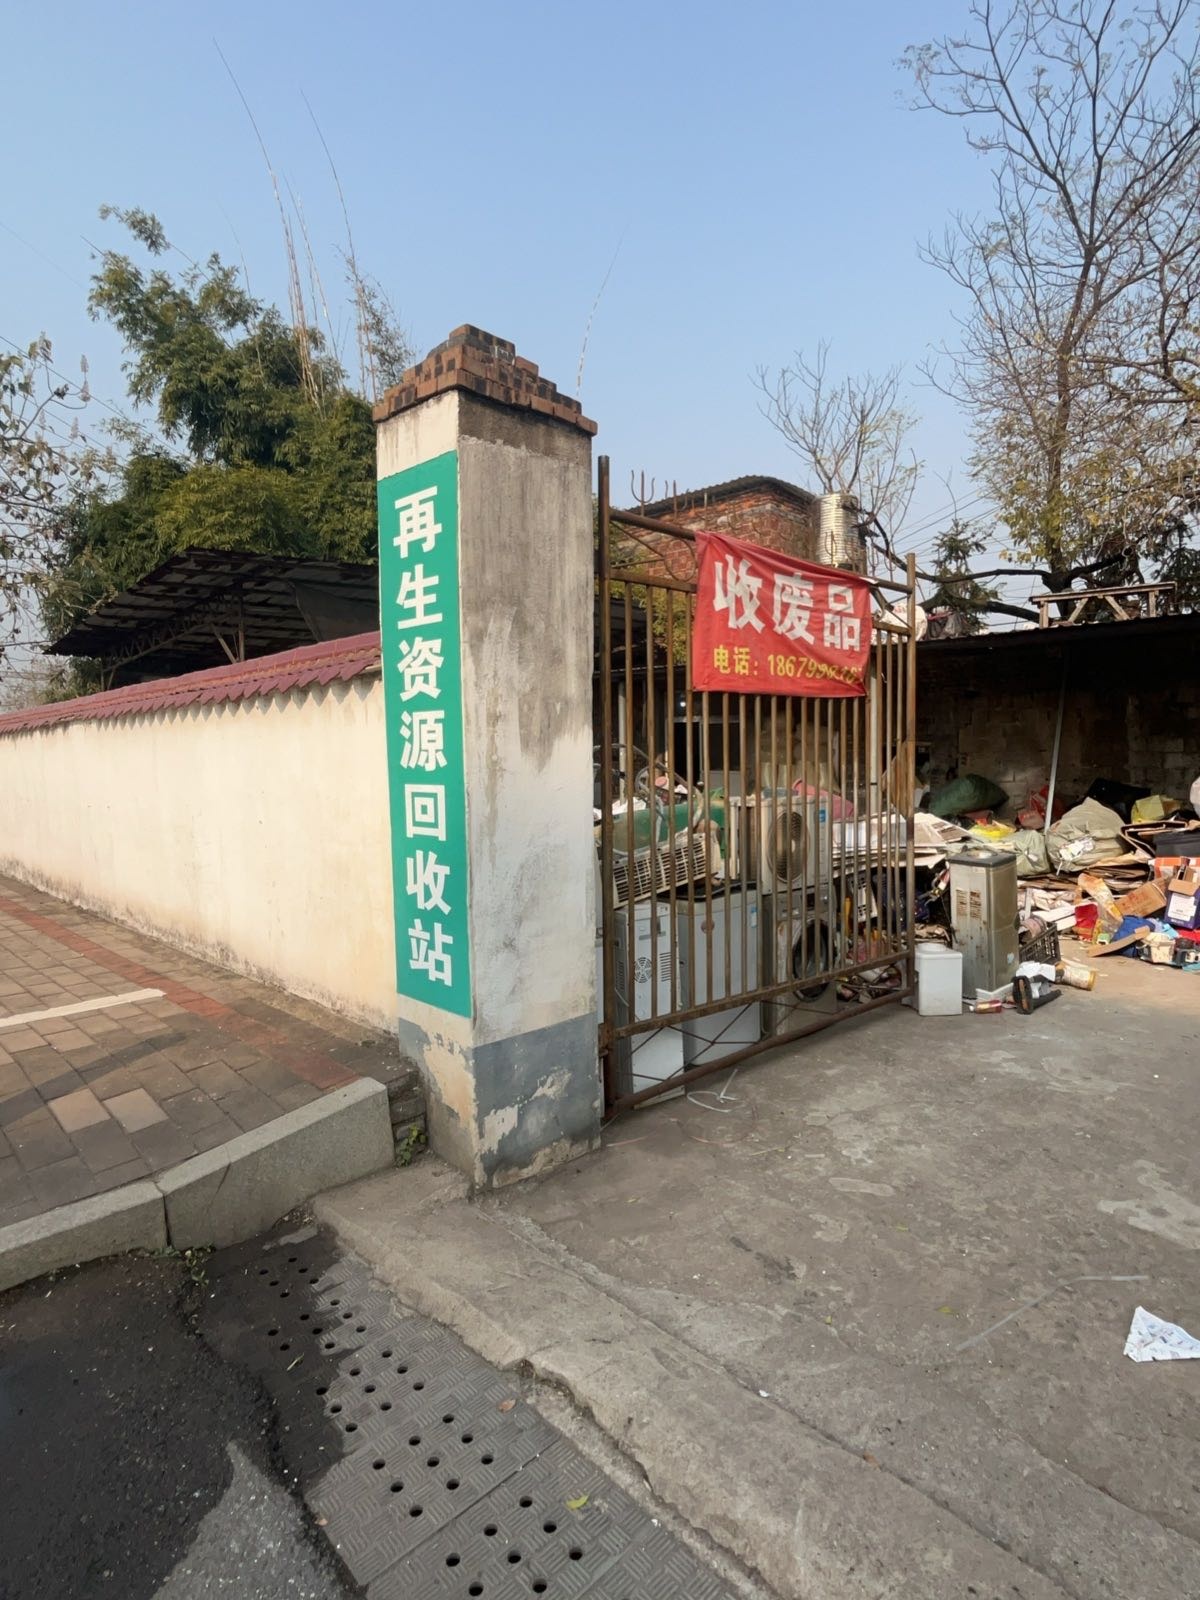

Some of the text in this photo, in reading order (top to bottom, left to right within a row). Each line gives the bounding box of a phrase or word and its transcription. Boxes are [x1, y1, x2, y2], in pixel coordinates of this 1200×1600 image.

[393, 486, 453, 986] 再生资源回收站
[713, 554, 861, 651] 收废品
